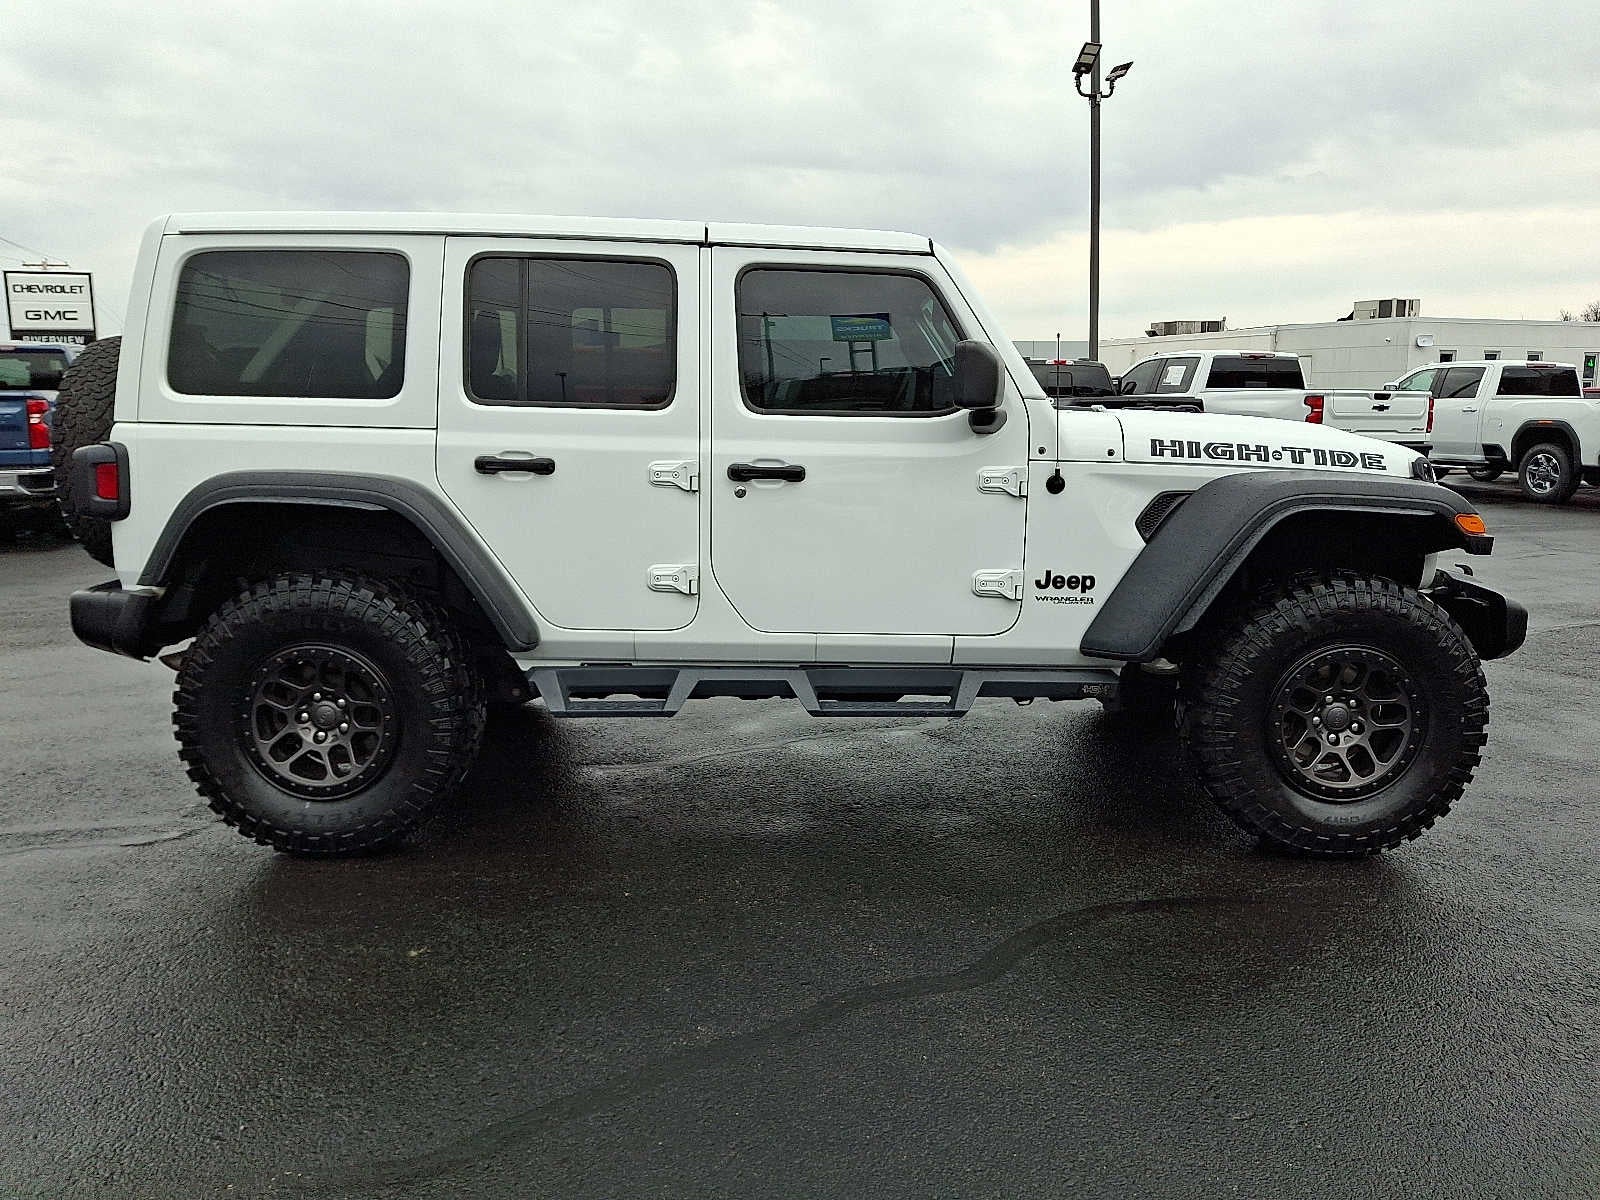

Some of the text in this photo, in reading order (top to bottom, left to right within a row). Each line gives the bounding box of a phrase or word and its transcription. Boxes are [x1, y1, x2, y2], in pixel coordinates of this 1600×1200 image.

[12, 284, 85, 294] CHEVROLET
[25, 310, 78, 320] GMC
[22, 335, 85, 345] RIVERVIEW
[1150, 438, 1387, 471] HIGH TIDE
[1034, 570, 1096, 594] Jeep
[1035, 595, 1094, 603] WRANGLER
